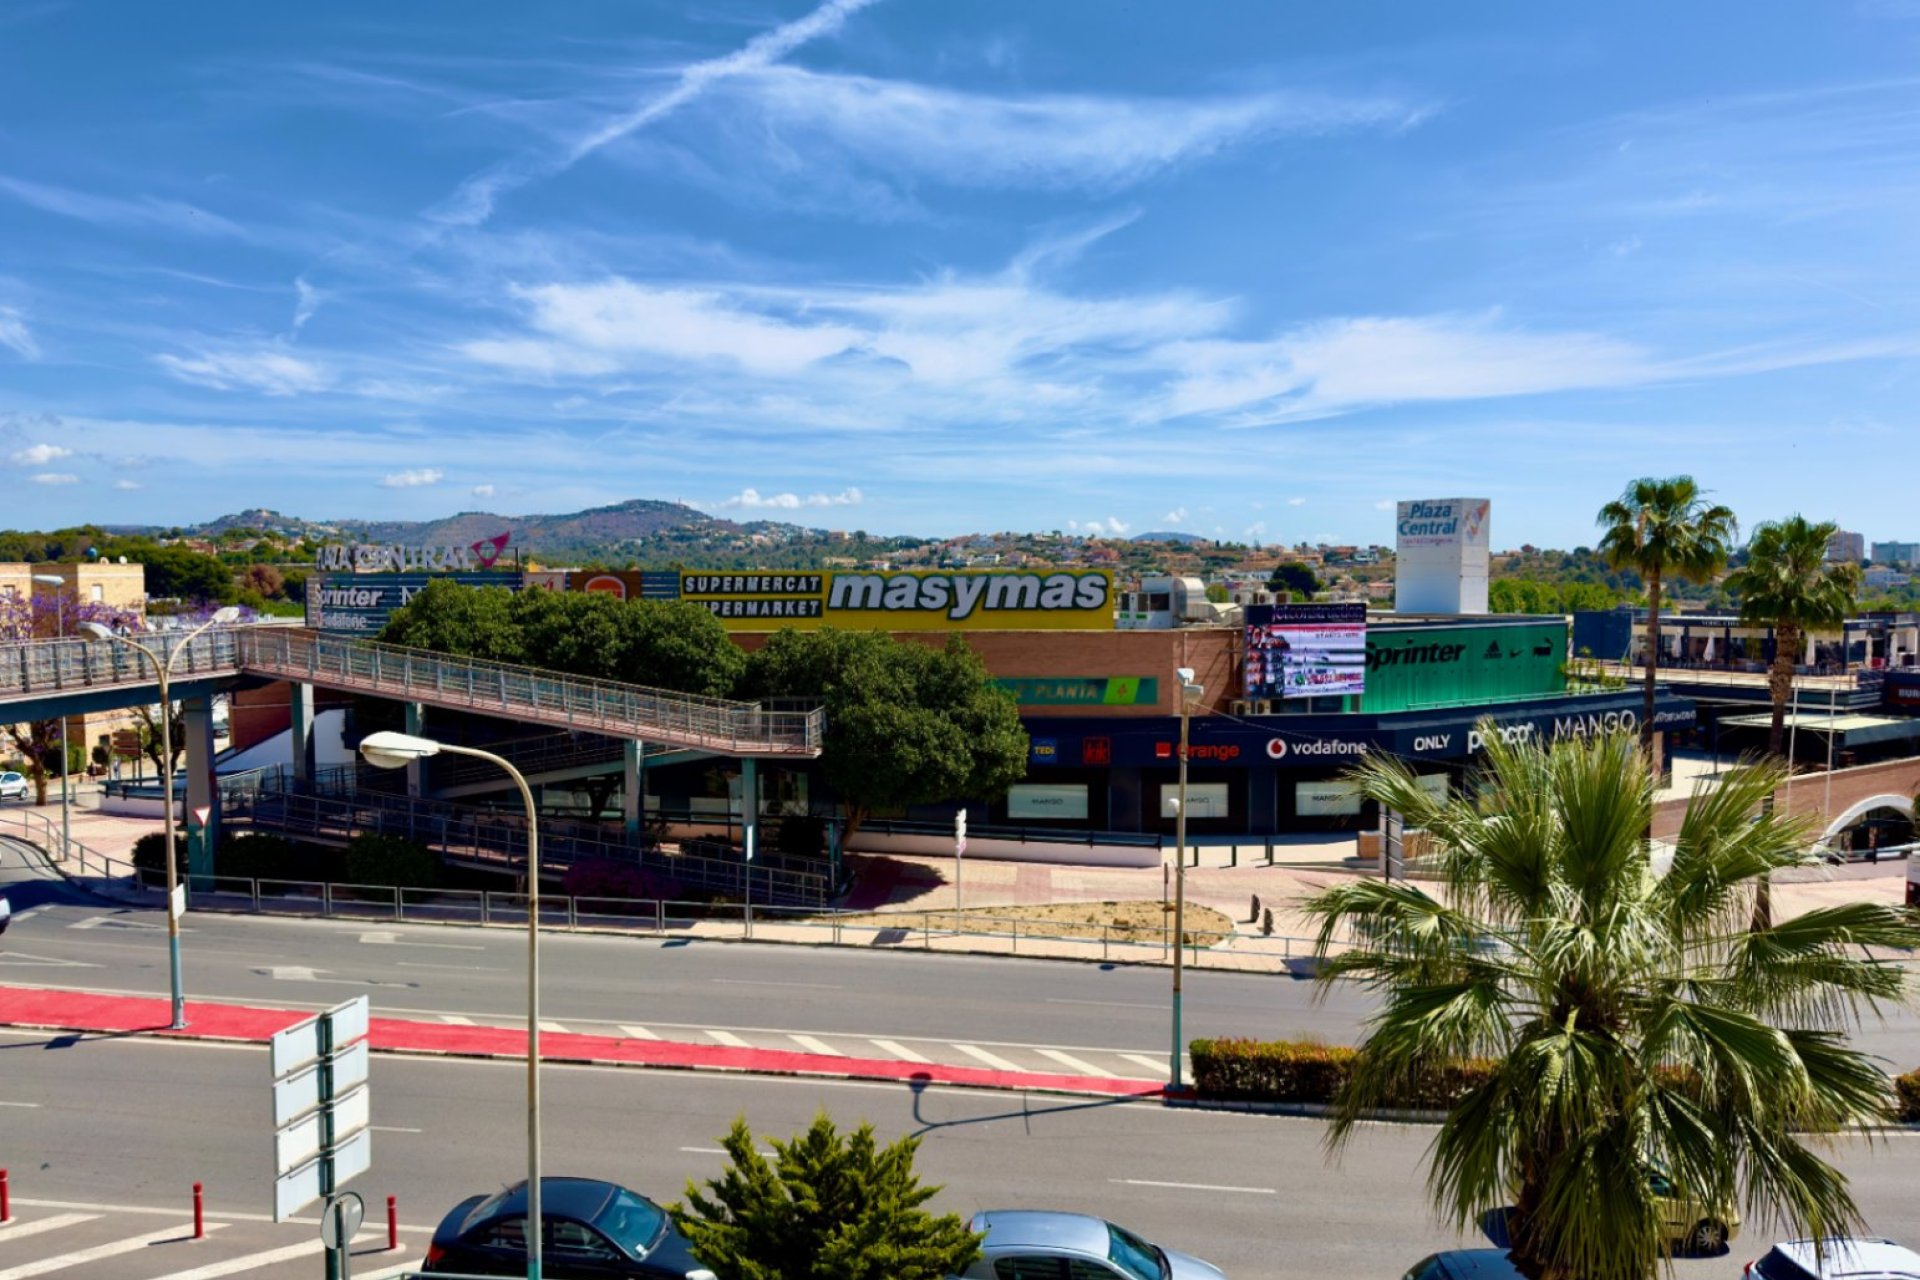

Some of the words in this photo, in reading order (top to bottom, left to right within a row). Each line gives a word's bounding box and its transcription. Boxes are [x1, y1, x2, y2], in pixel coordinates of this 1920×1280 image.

[1409, 502, 1452, 518] Plaza
[1399, 517, 1458, 536] Central
[355, 545, 470, 570] CENTRAL
[685, 576, 819, 593] SUPERMERCAT
[315, 583, 383, 608] Sprinter
[828, 574, 1108, 618] masymas
[703, 601, 819, 617] PERMARKET
[1366, 639, 1466, 672] Sprinter
[1554, 709, 1636, 741] MANGO
[1292, 738, 1367, 756] vodafone
[1414, 734, 1451, 751] ONLY
